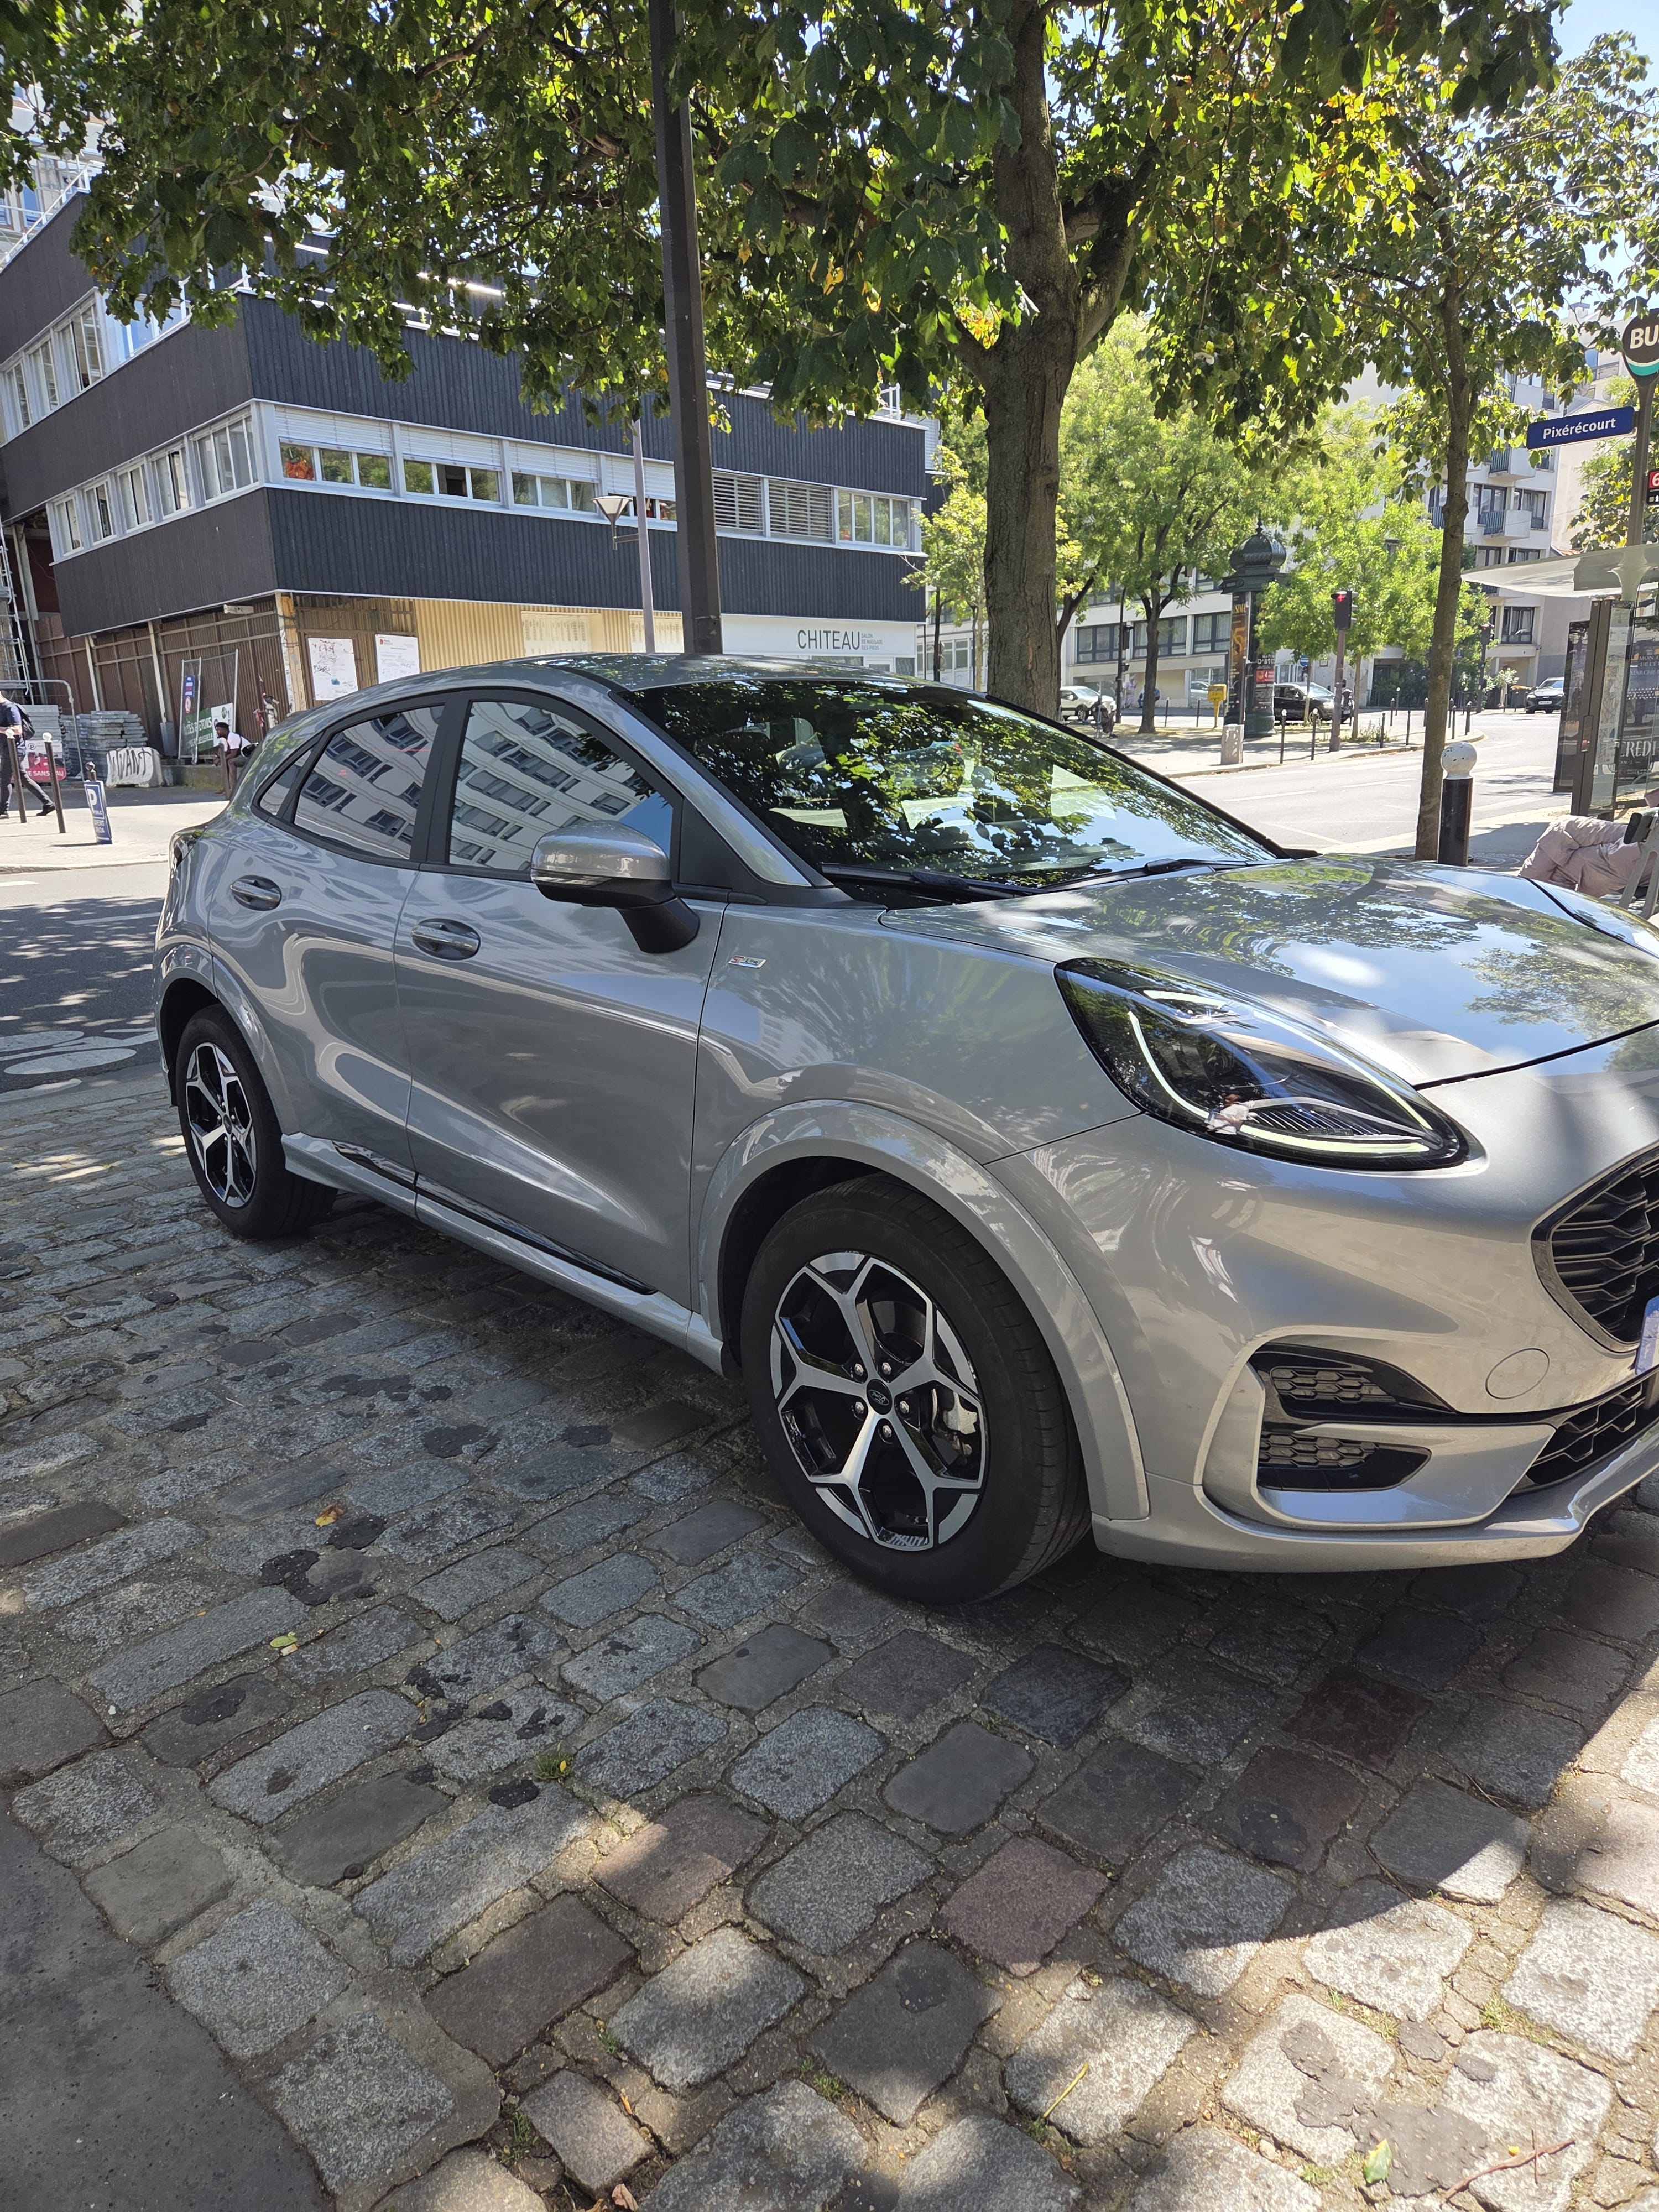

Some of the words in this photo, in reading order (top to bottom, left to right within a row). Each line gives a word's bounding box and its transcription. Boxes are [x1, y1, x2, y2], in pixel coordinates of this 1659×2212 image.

[1630, 325, 1659, 349] BU
[1543, 418, 1616, 439] Pixérécourt
[797, 629, 860, 650] CHITEAU
[87, 789, 97, 814] P
